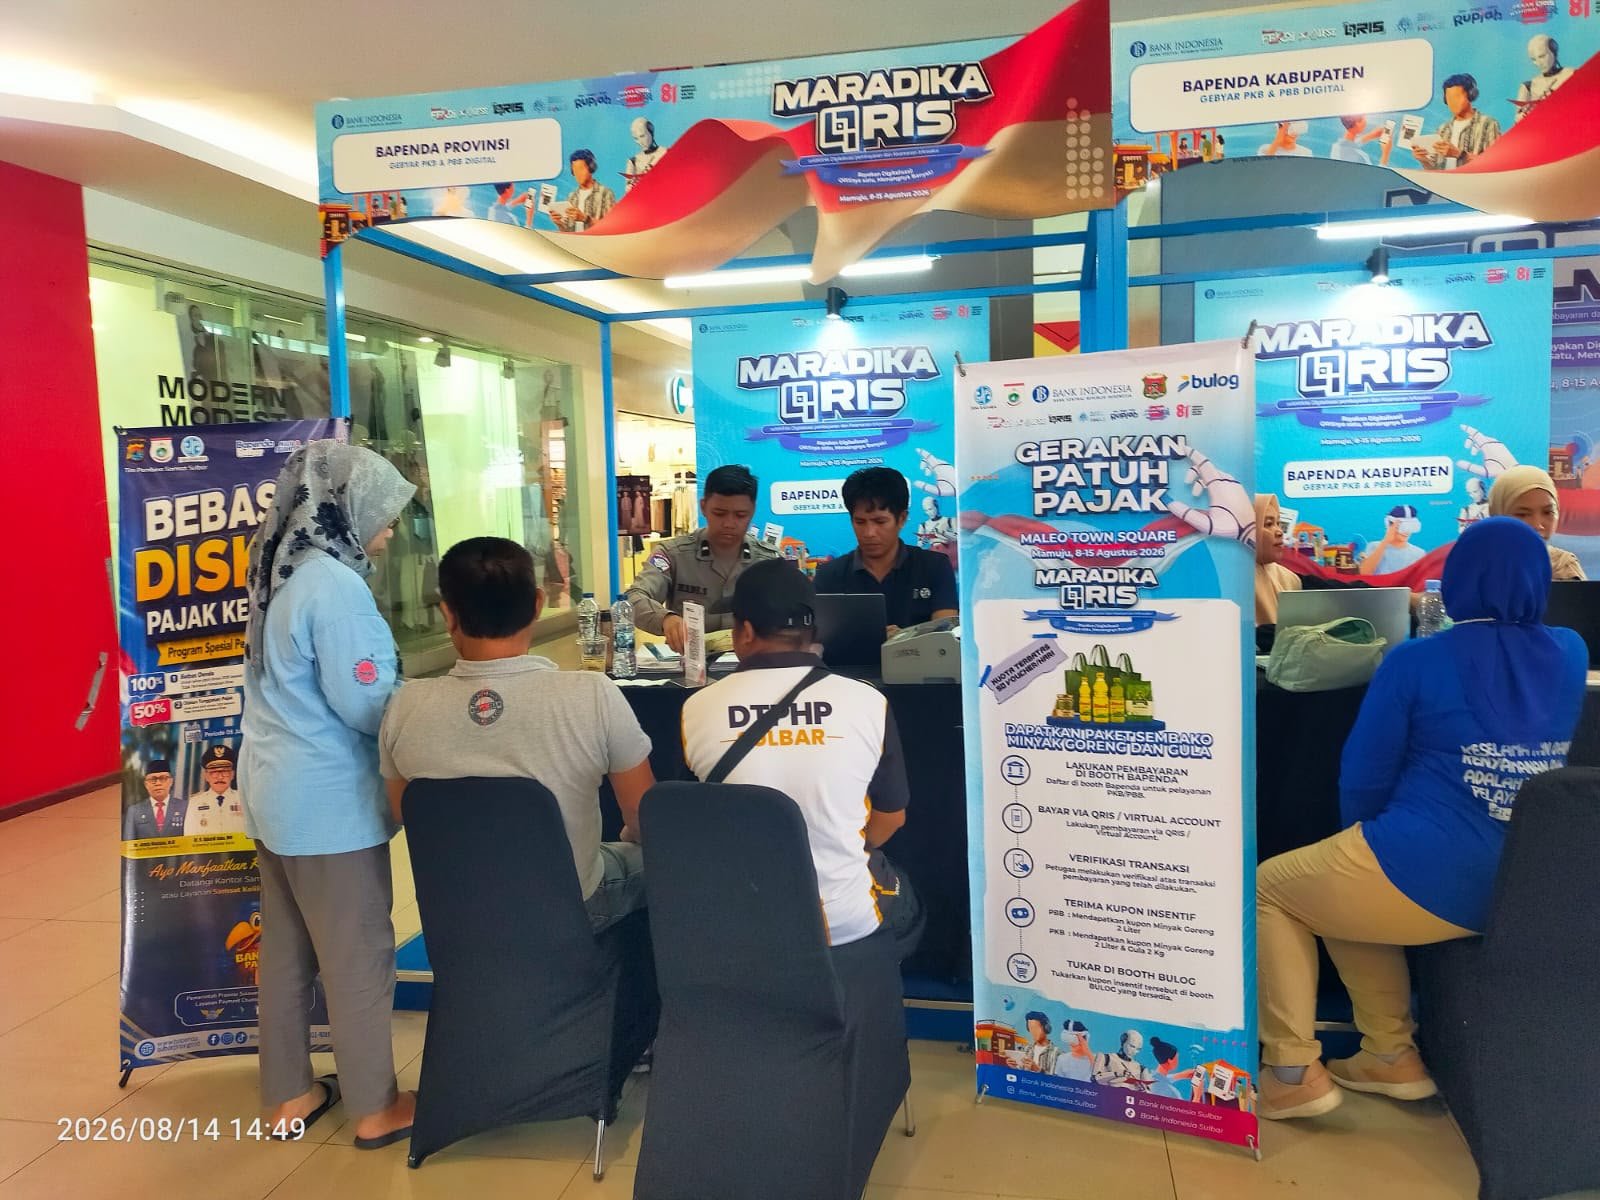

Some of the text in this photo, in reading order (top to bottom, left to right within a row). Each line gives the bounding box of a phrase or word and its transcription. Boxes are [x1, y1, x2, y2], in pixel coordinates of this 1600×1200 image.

[1343, 20, 1385, 37] QRIS
[1150, 38, 1223, 52] BANK INDONESIA
[773, 63, 992, 115] MARADIKA
[1183, 66, 1365, 92] BAPENDA KABUPATEN
[1200, 84, 1345, 104] GEBYAR PKB & PBB DIGITAL
[818, 100, 956, 154] QRIS
[376, 138, 510, 158] BAPENDA PROVINSI
[465, 156, 496, 165] DIGITAL
[1256, 314, 1491, 354] MARADIKA
[1552, 341, 1584, 352] yakan
[738, 348, 937, 384] MARADIKA
[1300, 348, 1449, 398] QRIS
[158, 375, 288, 407] MODERN
[1052, 384, 1132, 398] BANK INDONESIA
[1192, 373, 1239, 390] bulog
[1562, 378, 1586, 388] 8-15
[780, 378, 905, 423] QRIS
[1015, 435, 1187, 464] GERAKAN
[1032, 460, 1169, 490] PATUH
[1287, 465, 1449, 481] BAPENDA KABUPATEN
[781, 490, 839, 501] BAPENDA
[1303, 483, 1339, 491] GEBYAR
[1395, 480, 1433, 488] DIGITAL
[144, 480, 277, 542] BEBAS
[1033, 488, 1170, 516] PAJAK
[1020, 531, 1177, 545] MALEO TOWN SQUARE
[1031, 547, 1165, 560] Mamuju, 8-15 Agustus 2026
[1035, 568, 1159, 587] MARADIKA
[1060, 585, 1138, 609] QRIS
[146, 602, 218, 636] PAJAK
[168, 645, 204, 660] Program
[205, 640, 233, 656] Spesial
[130, 676, 163, 692] 100%
[134, 702, 167, 719] 50%
[738, 728, 825, 747] ULBAR
[1005, 723, 1213, 747] DAPATKAN PAKET SEMBAKO
[1007, 735, 1213, 760] MINYAK GORENG DAN GULA
[1065, 761, 1189, 777] LAKUKAN PEMBAYARAN
[1075, 770, 1178, 784] DI BOOTH BAPENDA
[1046, 777, 1070, 786] Daftar
[1080, 780, 1104, 788] booth
[1105, 782, 1141, 792] Bapenda
[1143, 784, 1167, 793] untuk
[1168, 787, 1212, 797] pelayanan
[1038, 805, 1222, 828] BAYAR VIA QRIS VIRTUAL ACCOUNT
[1066, 820, 1099, 830] Lakukan
[1100, 824, 1150, 835] pembayaran
[1165, 828, 1186, 838] QRIS
[1095, 830, 1159, 841] Virtual Account.
[149, 858, 248, 881] Ayo Manfaatkan
[1068, 853, 1190, 874] VERIFIKASI TRANSAKSI
[179, 876, 242, 889] Datangi Kantor
[1045, 863, 1216, 888] Petugas melakukan verifikasi atas transaksi
[1062, 873, 1197, 894] pembayaran yang telah dilakukan.
[1064, 898, 1197, 922] TERIMA KUPON INSENTIF
[1048, 909, 1215, 937] PBB Mendapatkan kupon Minyak Goreng
[1124, 926, 1141, 935] Liter
[1049, 928, 1215, 957] PKB Mendapatkan kupon Minyak Goreng
[1101, 942, 1116, 951] Liter
[1125, 946, 1146, 955] Gula
[1154, 950, 1165, 959] Kg
[1066, 959, 1197, 986] TUKAR DI BOOTH BULOG
[1051, 970, 1214, 1000] Tukarkan kupon insentif tersebut di booth
[1089, 983, 1116, 993] BULOG
[1117, 988, 1137, 998] yang
[1139, 1099, 1223, 1121] Bank Indonesia Sulbar
[1140, 1111, 1224, 1134] Bank Indonesia Sulbar
